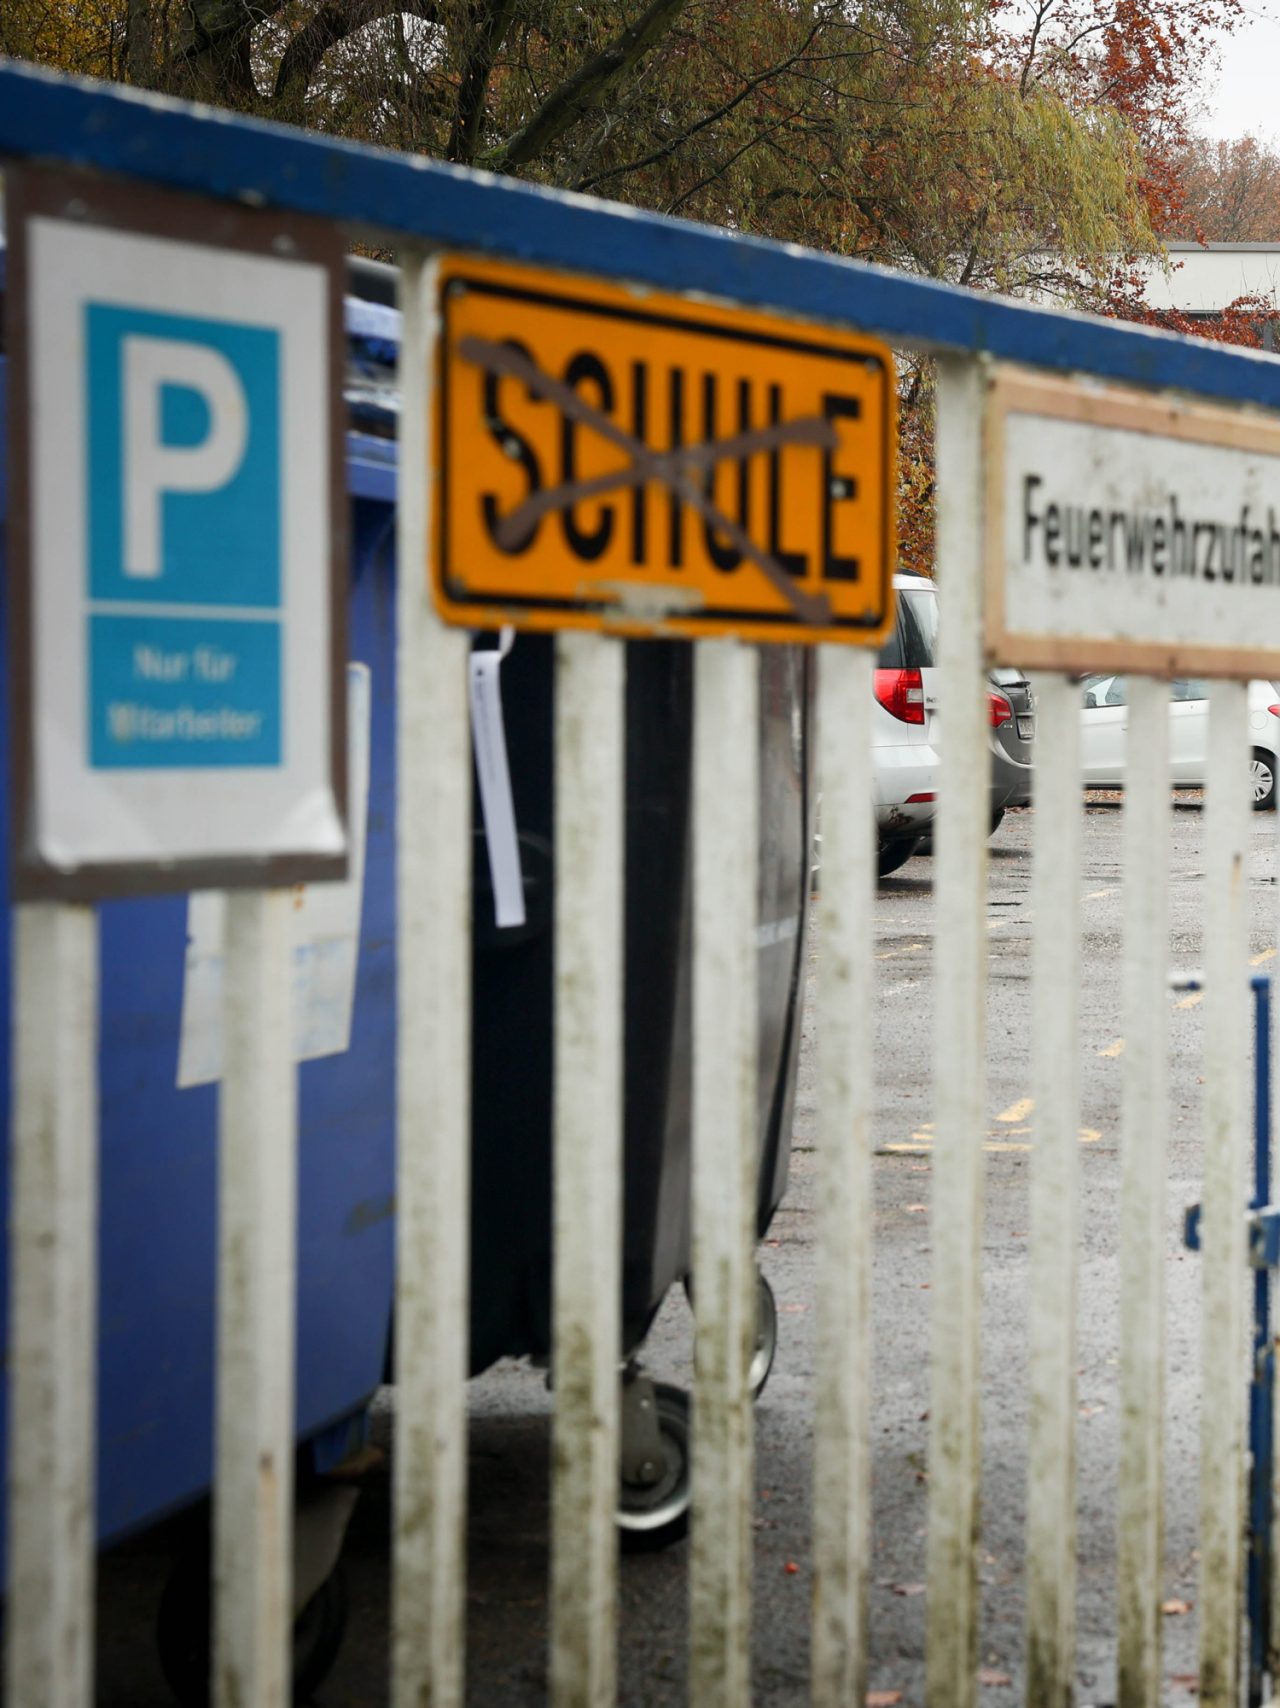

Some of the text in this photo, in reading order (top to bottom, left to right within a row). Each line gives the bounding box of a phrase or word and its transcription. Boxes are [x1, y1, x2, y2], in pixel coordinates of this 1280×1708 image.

[122, 333, 250, 579] P
[479, 338, 862, 584] SCHULE
[134, 643, 239, 682] Nur für
